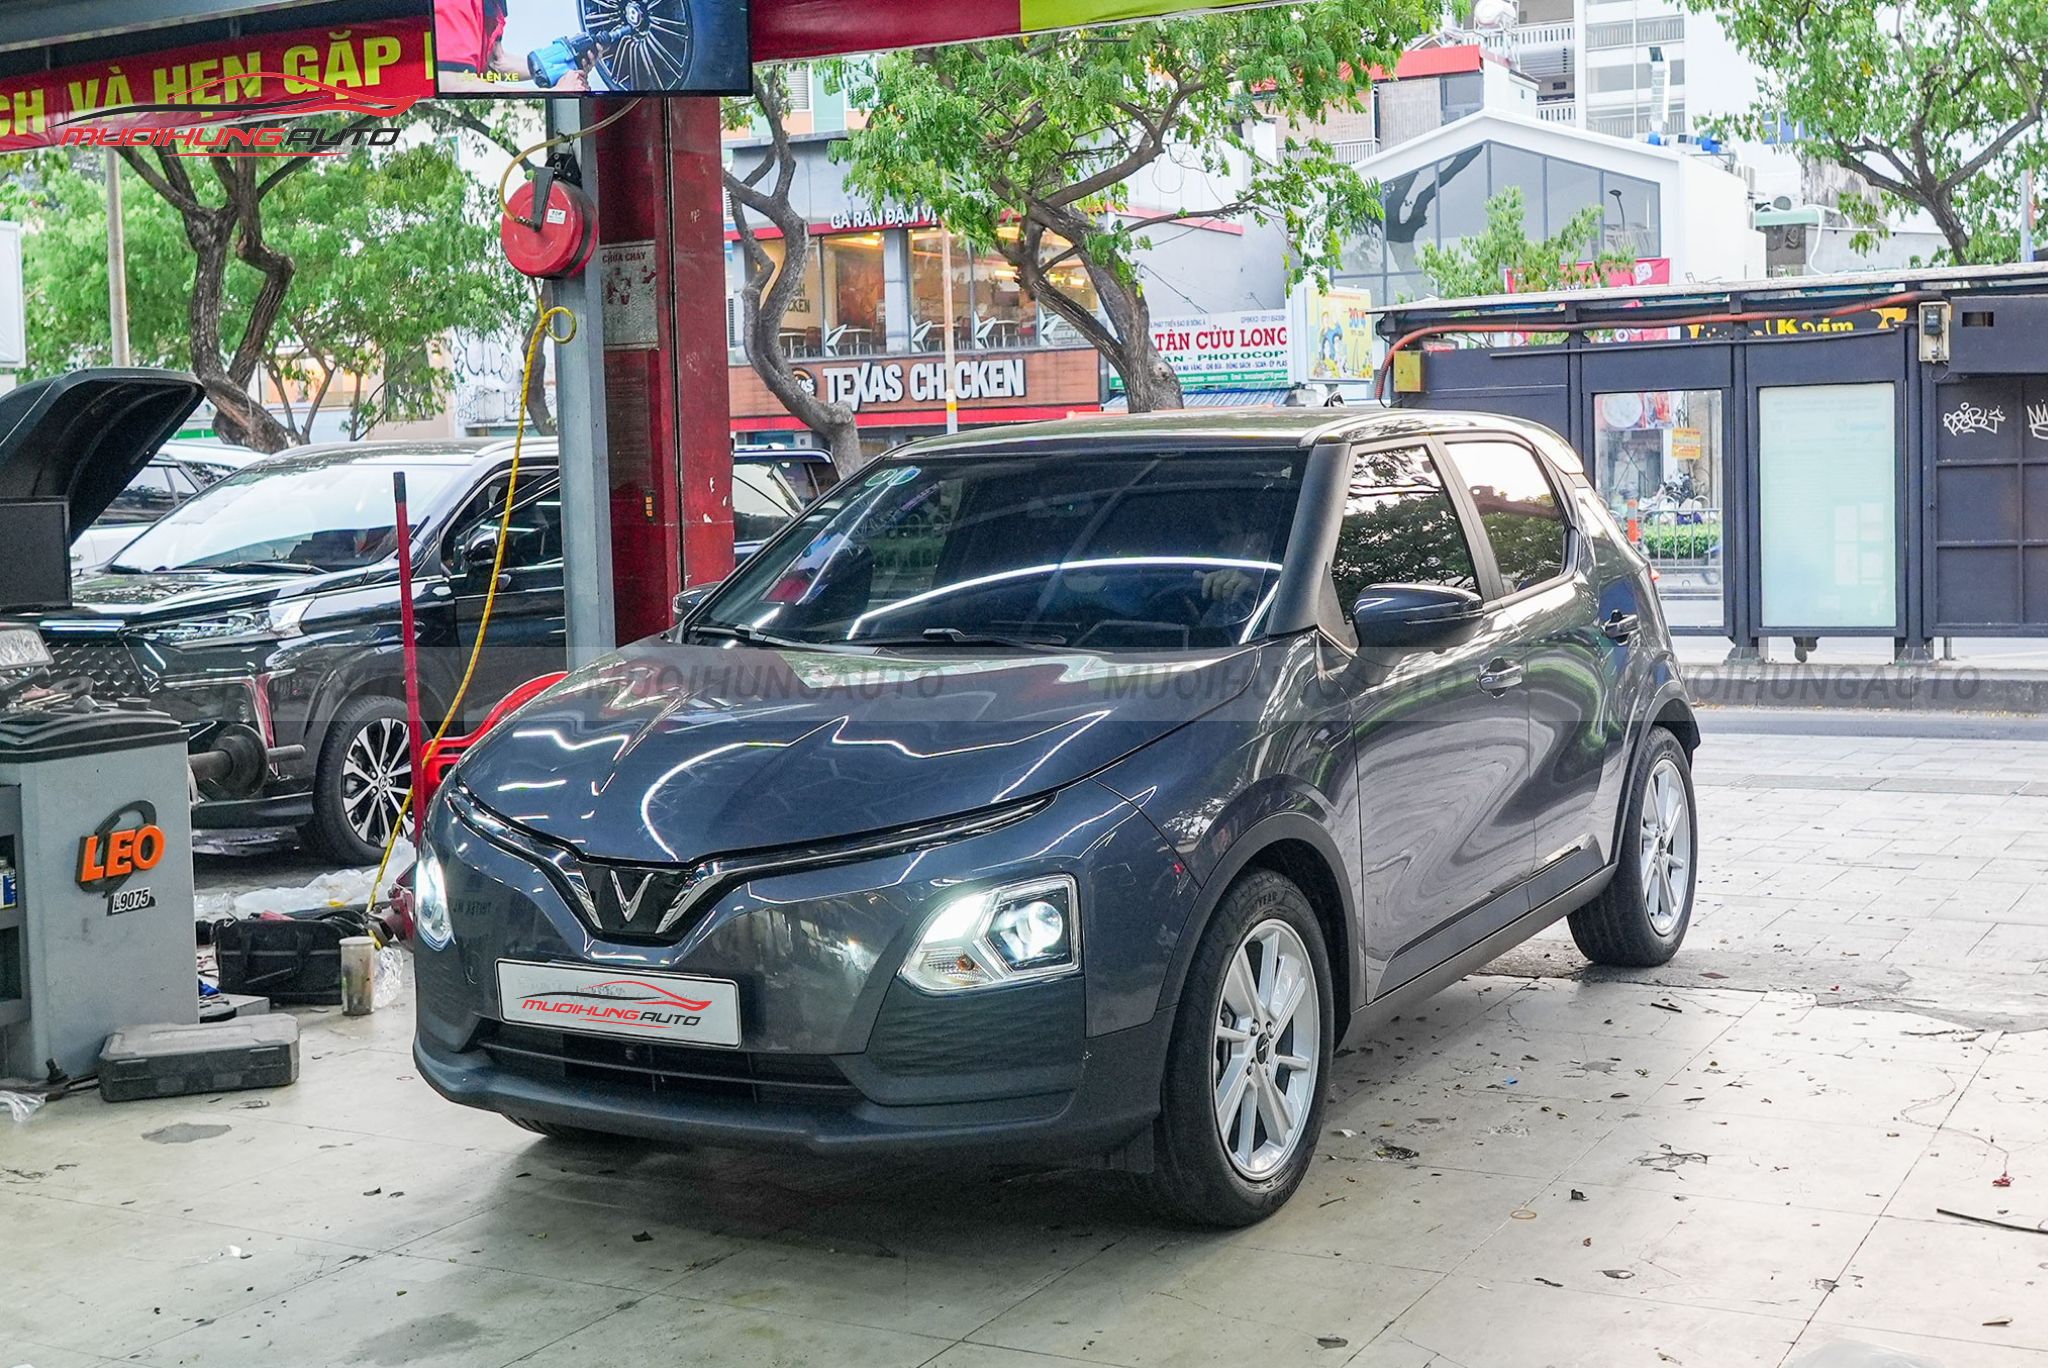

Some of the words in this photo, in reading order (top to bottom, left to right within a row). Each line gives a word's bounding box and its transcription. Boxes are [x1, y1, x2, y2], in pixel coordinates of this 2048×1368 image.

[68, 66, 134, 126] VÀ
[152, 51, 262, 119] HẸN
[283, 30, 402, 99] GẶP
[1155, 329, 1190, 352] TÂN
[1196, 324, 1234, 350] CỬU
[1198, 350, 1287, 362] PHOTOCOP
[822, 362, 904, 411] TEXAS
[909, 359, 1026, 401] CHCKEN
[80, 824, 166, 882] LEO
[112, 888, 150, 913] L9075
